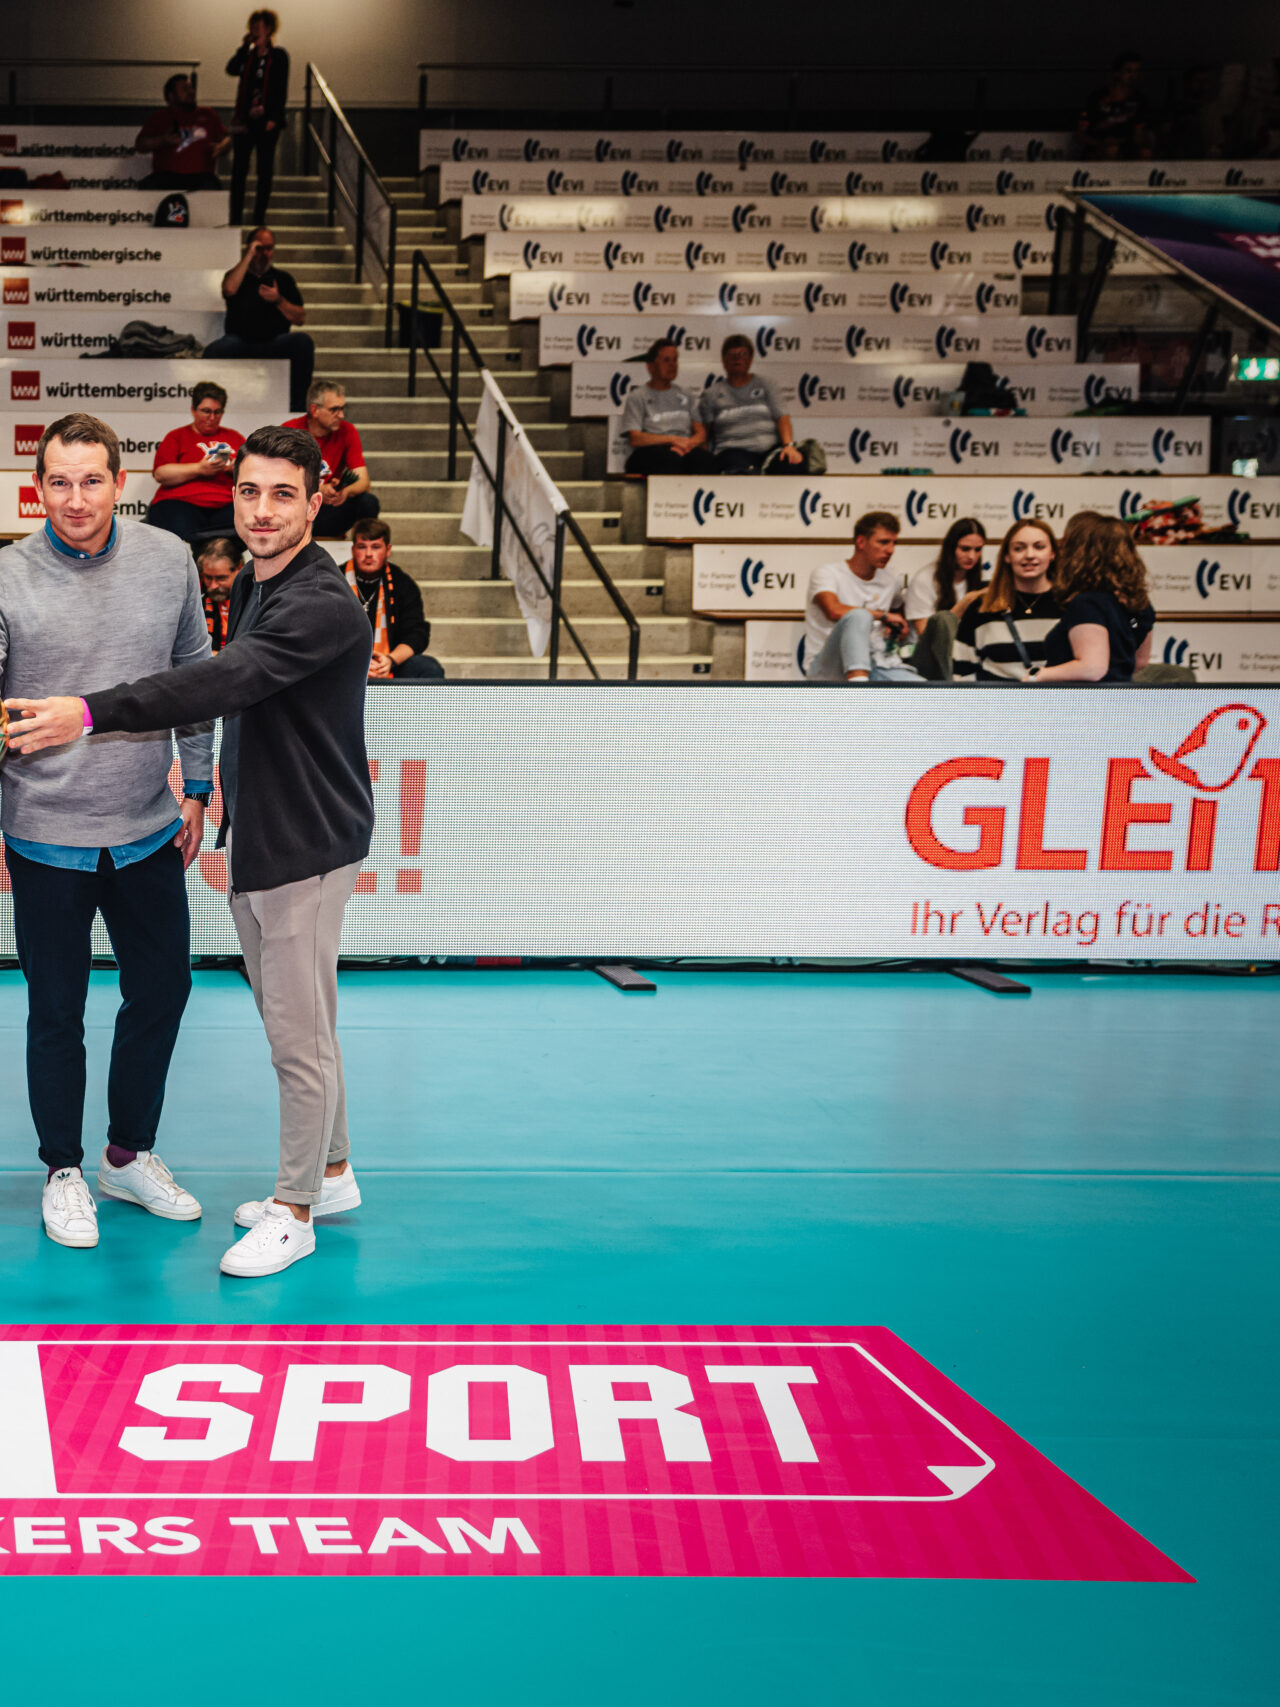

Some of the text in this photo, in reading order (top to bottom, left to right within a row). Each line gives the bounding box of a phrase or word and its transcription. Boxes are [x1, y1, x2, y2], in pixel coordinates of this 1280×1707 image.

[31, 247, 161, 262] württembergische
[540, 252, 562, 264] EVI
[621, 252, 644, 264] EVI
[702, 252, 725, 264] EVI
[783, 252, 807, 264] EVI
[866, 252, 889, 264] EVI
[949, 252, 971, 264] EVI
[35, 288, 171, 306] württembergische
[566, 293, 590, 306] EVI
[651, 293, 675, 306] EVI
[736, 293, 761, 306] EVI
[822, 293, 846, 306] EVI
[908, 293, 932, 306] EVI
[993, 293, 1018, 306] EVI
[596, 337, 620, 351] EVI
[685, 337, 710, 351] EVI
[775, 337, 800, 351] EVI
[865, 337, 890, 351] EVI
[955, 337, 979, 351] EVI
[1045, 337, 1070, 351] EVI
[46, 382, 194, 402] württembergische
[819, 387, 845, 400] EVI
[913, 387, 939, 400] EVI
[870, 441, 898, 456] EVI
[971, 441, 999, 456] EVI
[1071, 441, 1100, 456] EVI
[1174, 441, 1202, 456] EVI
[715, 503, 744, 518] EVI
[822, 503, 850, 518] EVI
[928, 503, 956, 518] EVI
[1035, 503, 1064, 518] EVI
[1250, 503, 1280, 518] EVI
[764, 573, 795, 589] EVI
[1220, 574, 1251, 590] EVI
[1189, 653, 1222, 670] EVI
[909, 901, 963, 937] Ihr
[975, 901, 1100, 946] Verlag
[1116, 900, 1172, 938] für
[1183, 902, 1247, 938] die
[117, 1364, 820, 1463] SPORT
[229, 1516, 542, 1557] TEAM
